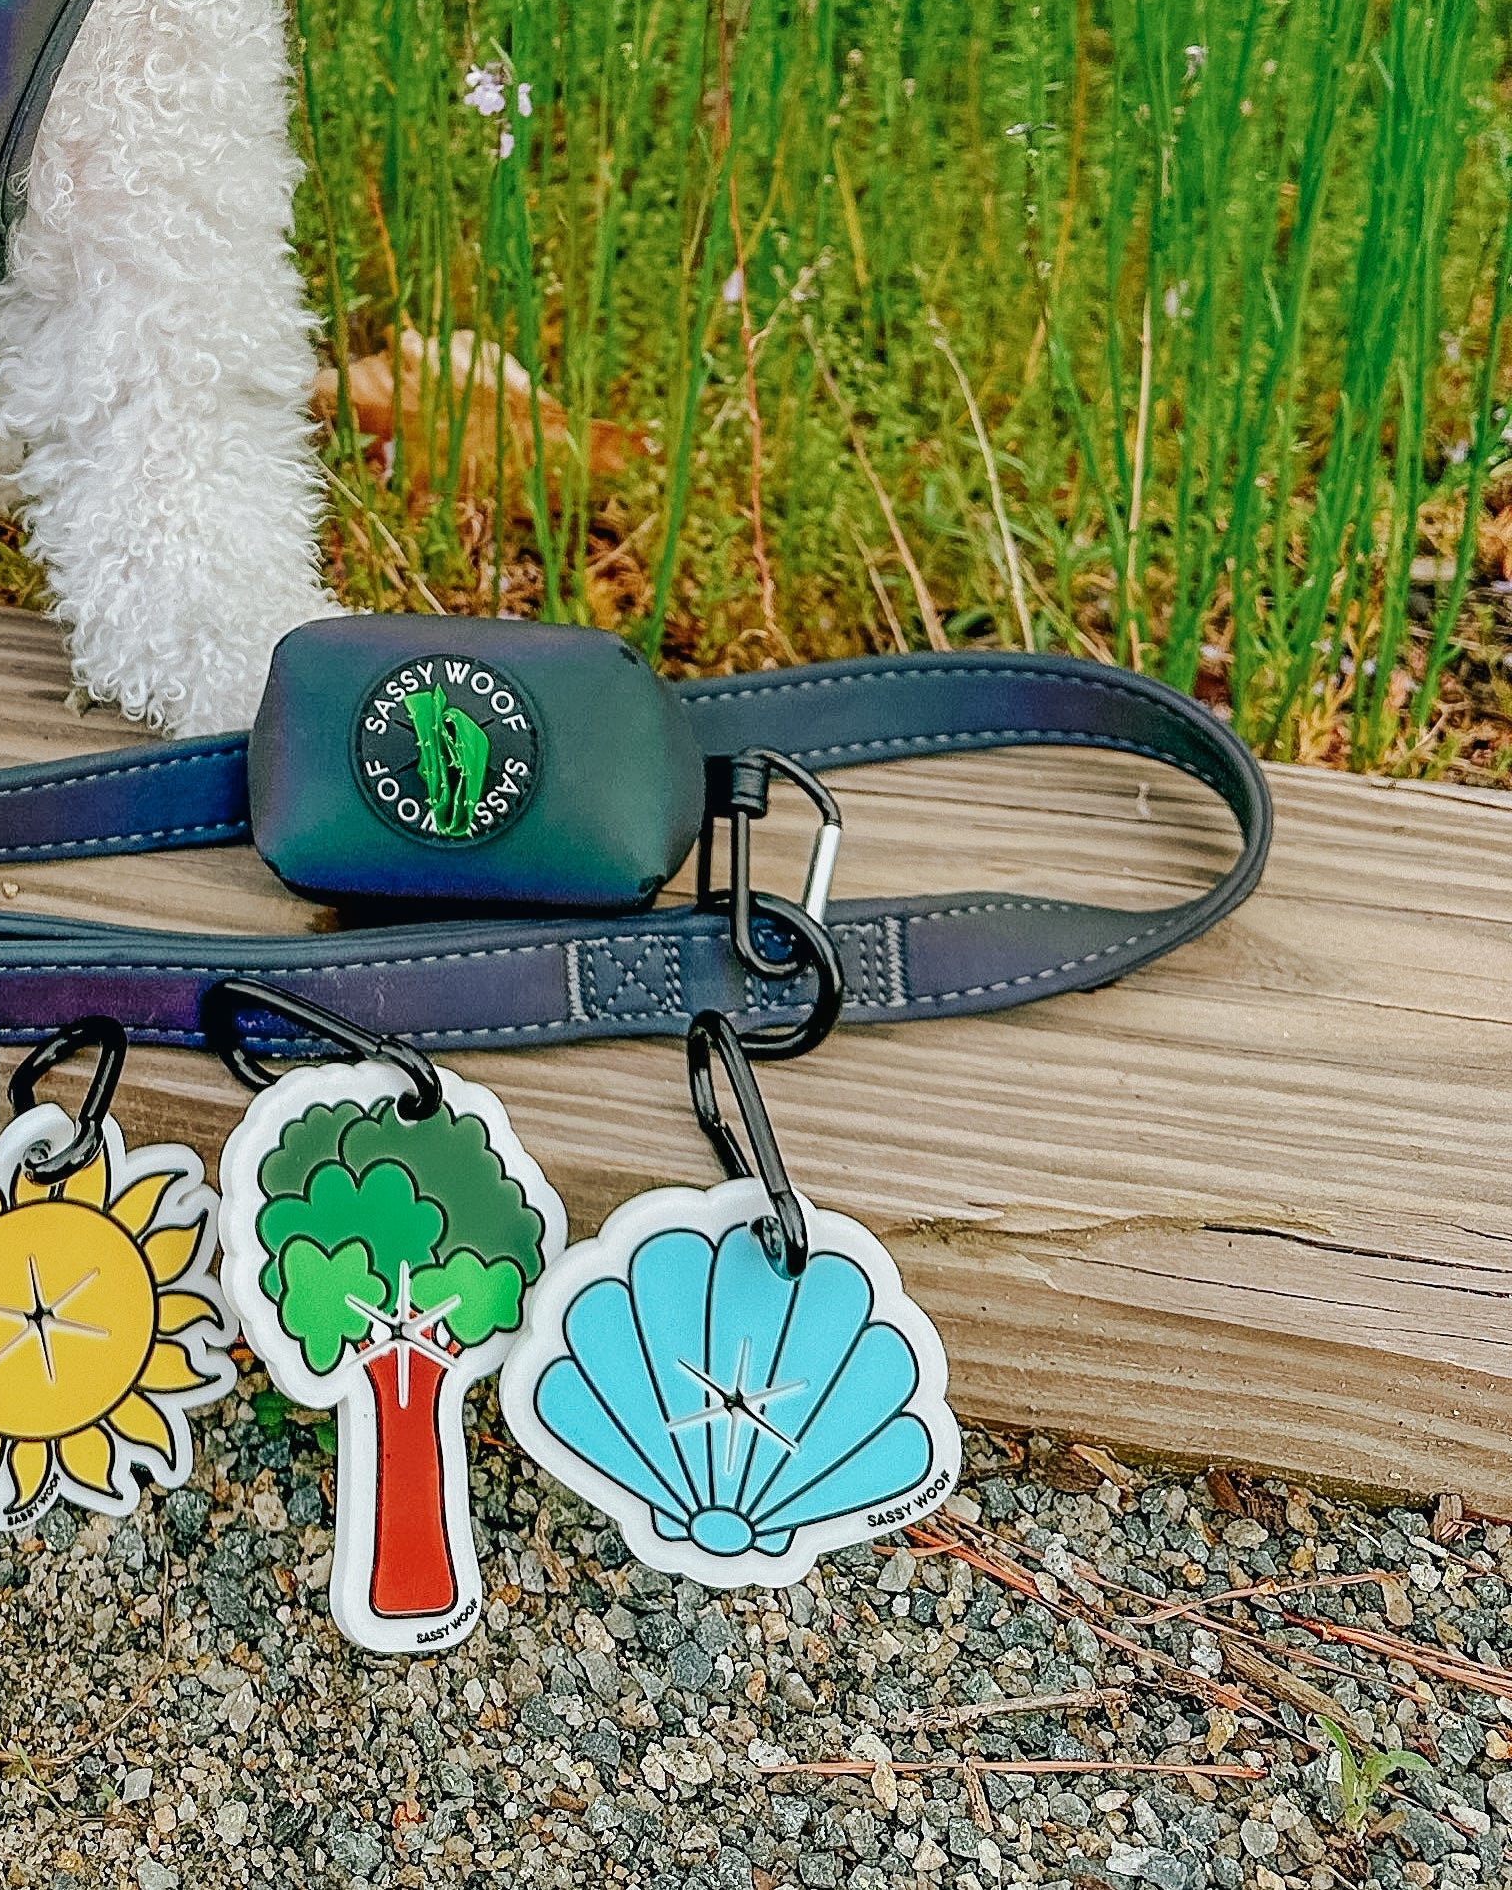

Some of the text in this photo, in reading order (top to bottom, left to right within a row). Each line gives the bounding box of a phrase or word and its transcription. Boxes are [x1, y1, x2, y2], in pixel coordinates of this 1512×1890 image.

[364, 660, 527, 735] SASSY WOOF
[867, 1469, 951, 1527] SASSY WOOF
[416, 1597, 478, 1644] SASSY WOOF
